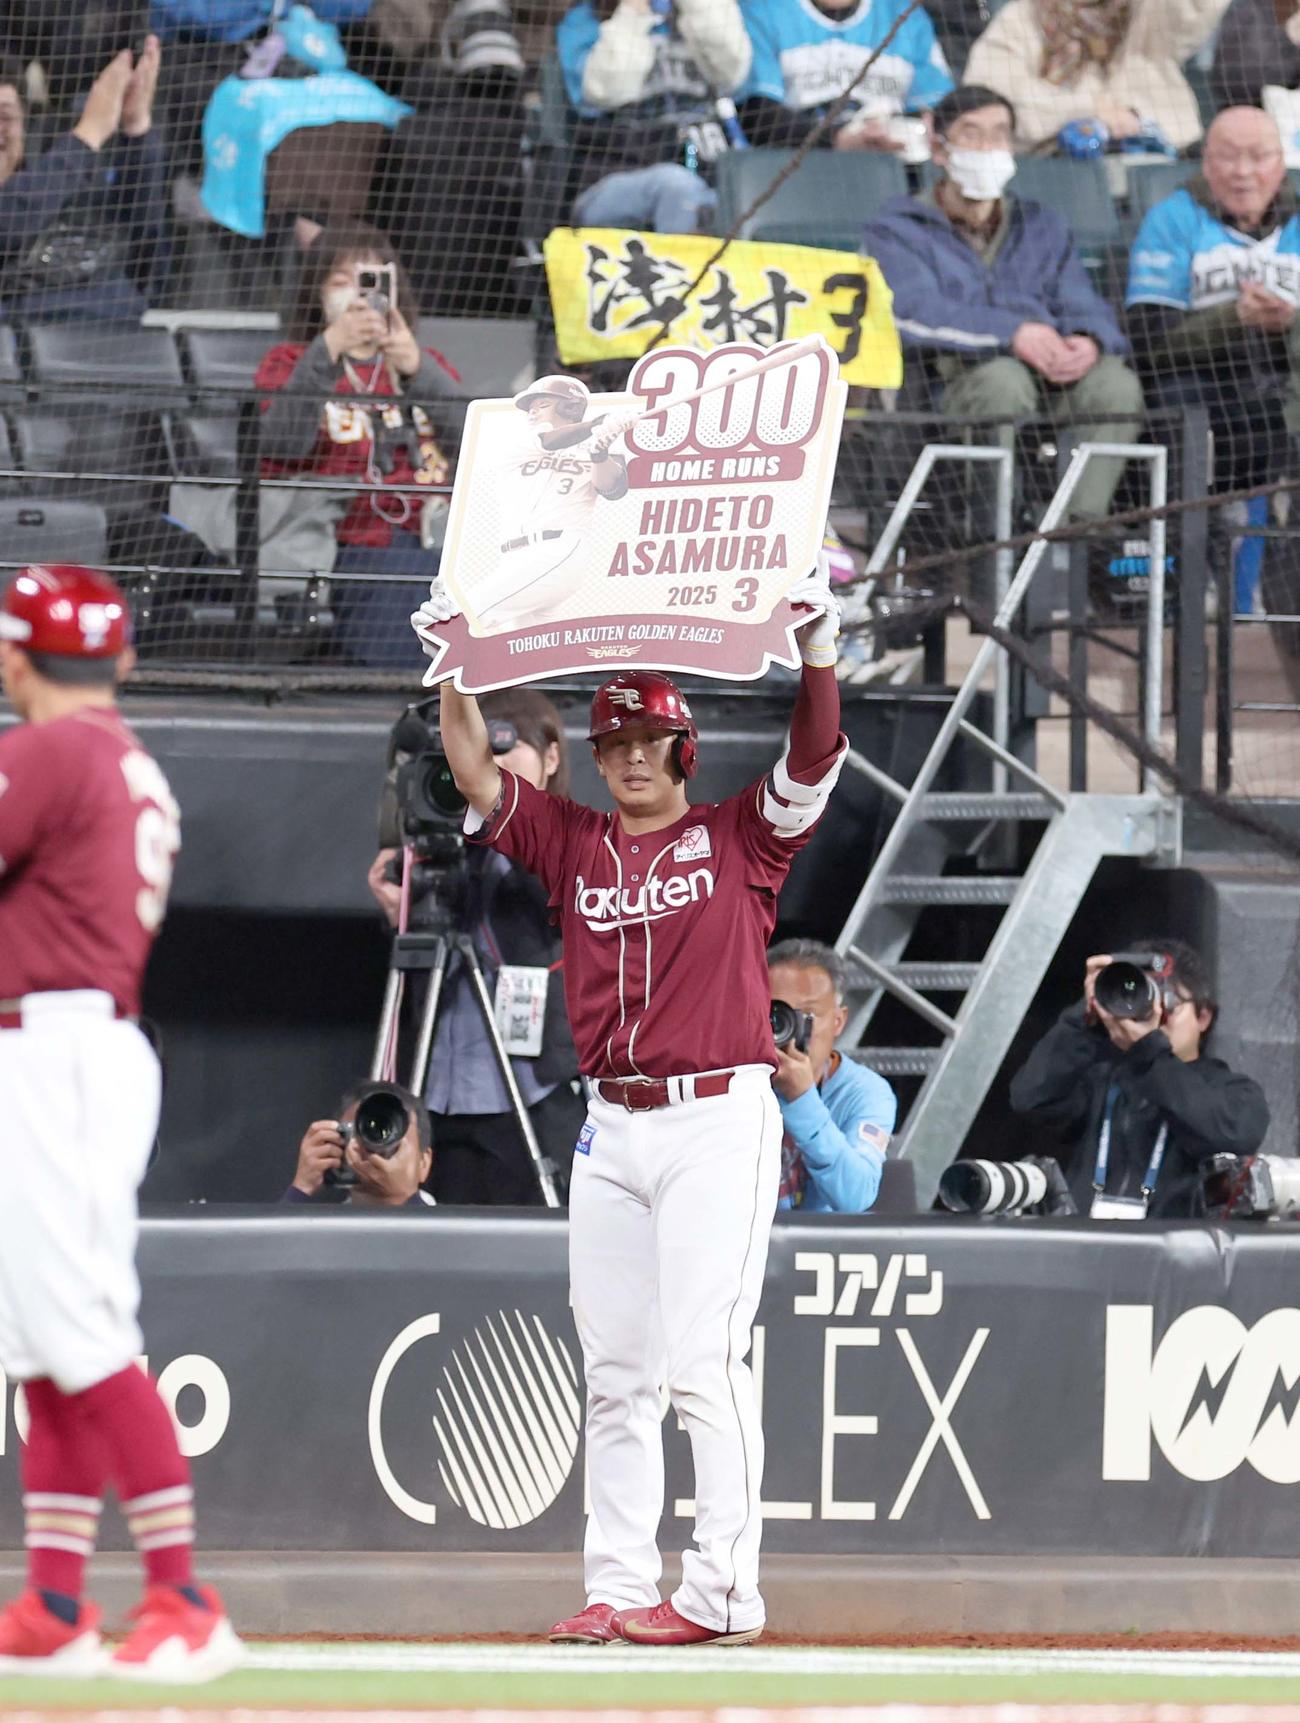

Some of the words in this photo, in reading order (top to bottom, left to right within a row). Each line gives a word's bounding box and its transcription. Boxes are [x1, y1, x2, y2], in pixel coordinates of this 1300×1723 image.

[823, 273, 868, 364] 3
[629, 344, 826, 453] 300
[557, 477, 574, 496] 3
[650, 459, 716, 483] HOME
[721, 455, 781, 478] RUNS
[638, 494, 774, 536] HIDETO
[607, 533, 788, 577] ASAMURA
[666, 585, 718, 607] 2025
[731, 576, 760, 613] 3
[507, 631, 560, 655] TOHOKU
[564, 624, 625, 646] RAKUTEN
[628, 623, 678, 641] GOLDEN
[678, 625, 725, 645] EAGLES
[593, 647, 634, 659] EAGLES
